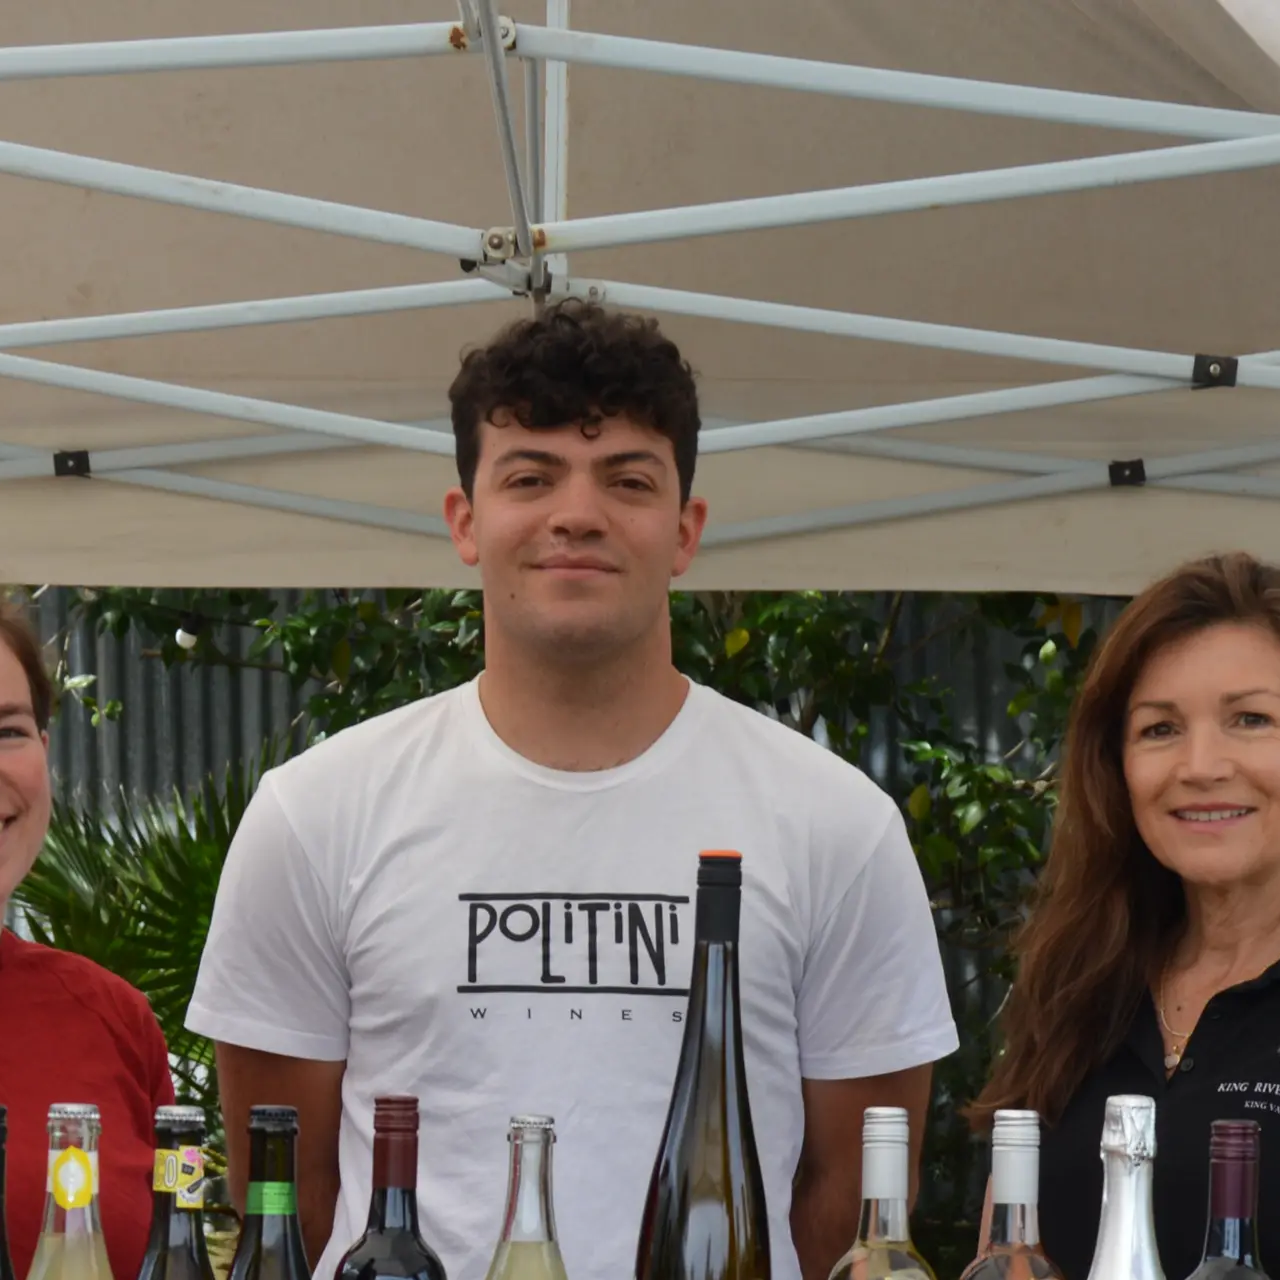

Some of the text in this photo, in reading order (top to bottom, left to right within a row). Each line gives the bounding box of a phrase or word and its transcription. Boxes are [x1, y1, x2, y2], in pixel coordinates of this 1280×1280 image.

[470, 1007, 683, 1022] WINES
[1217, 1082, 1249, 1093] KING
[1244, 1100, 1267, 1110] KING
